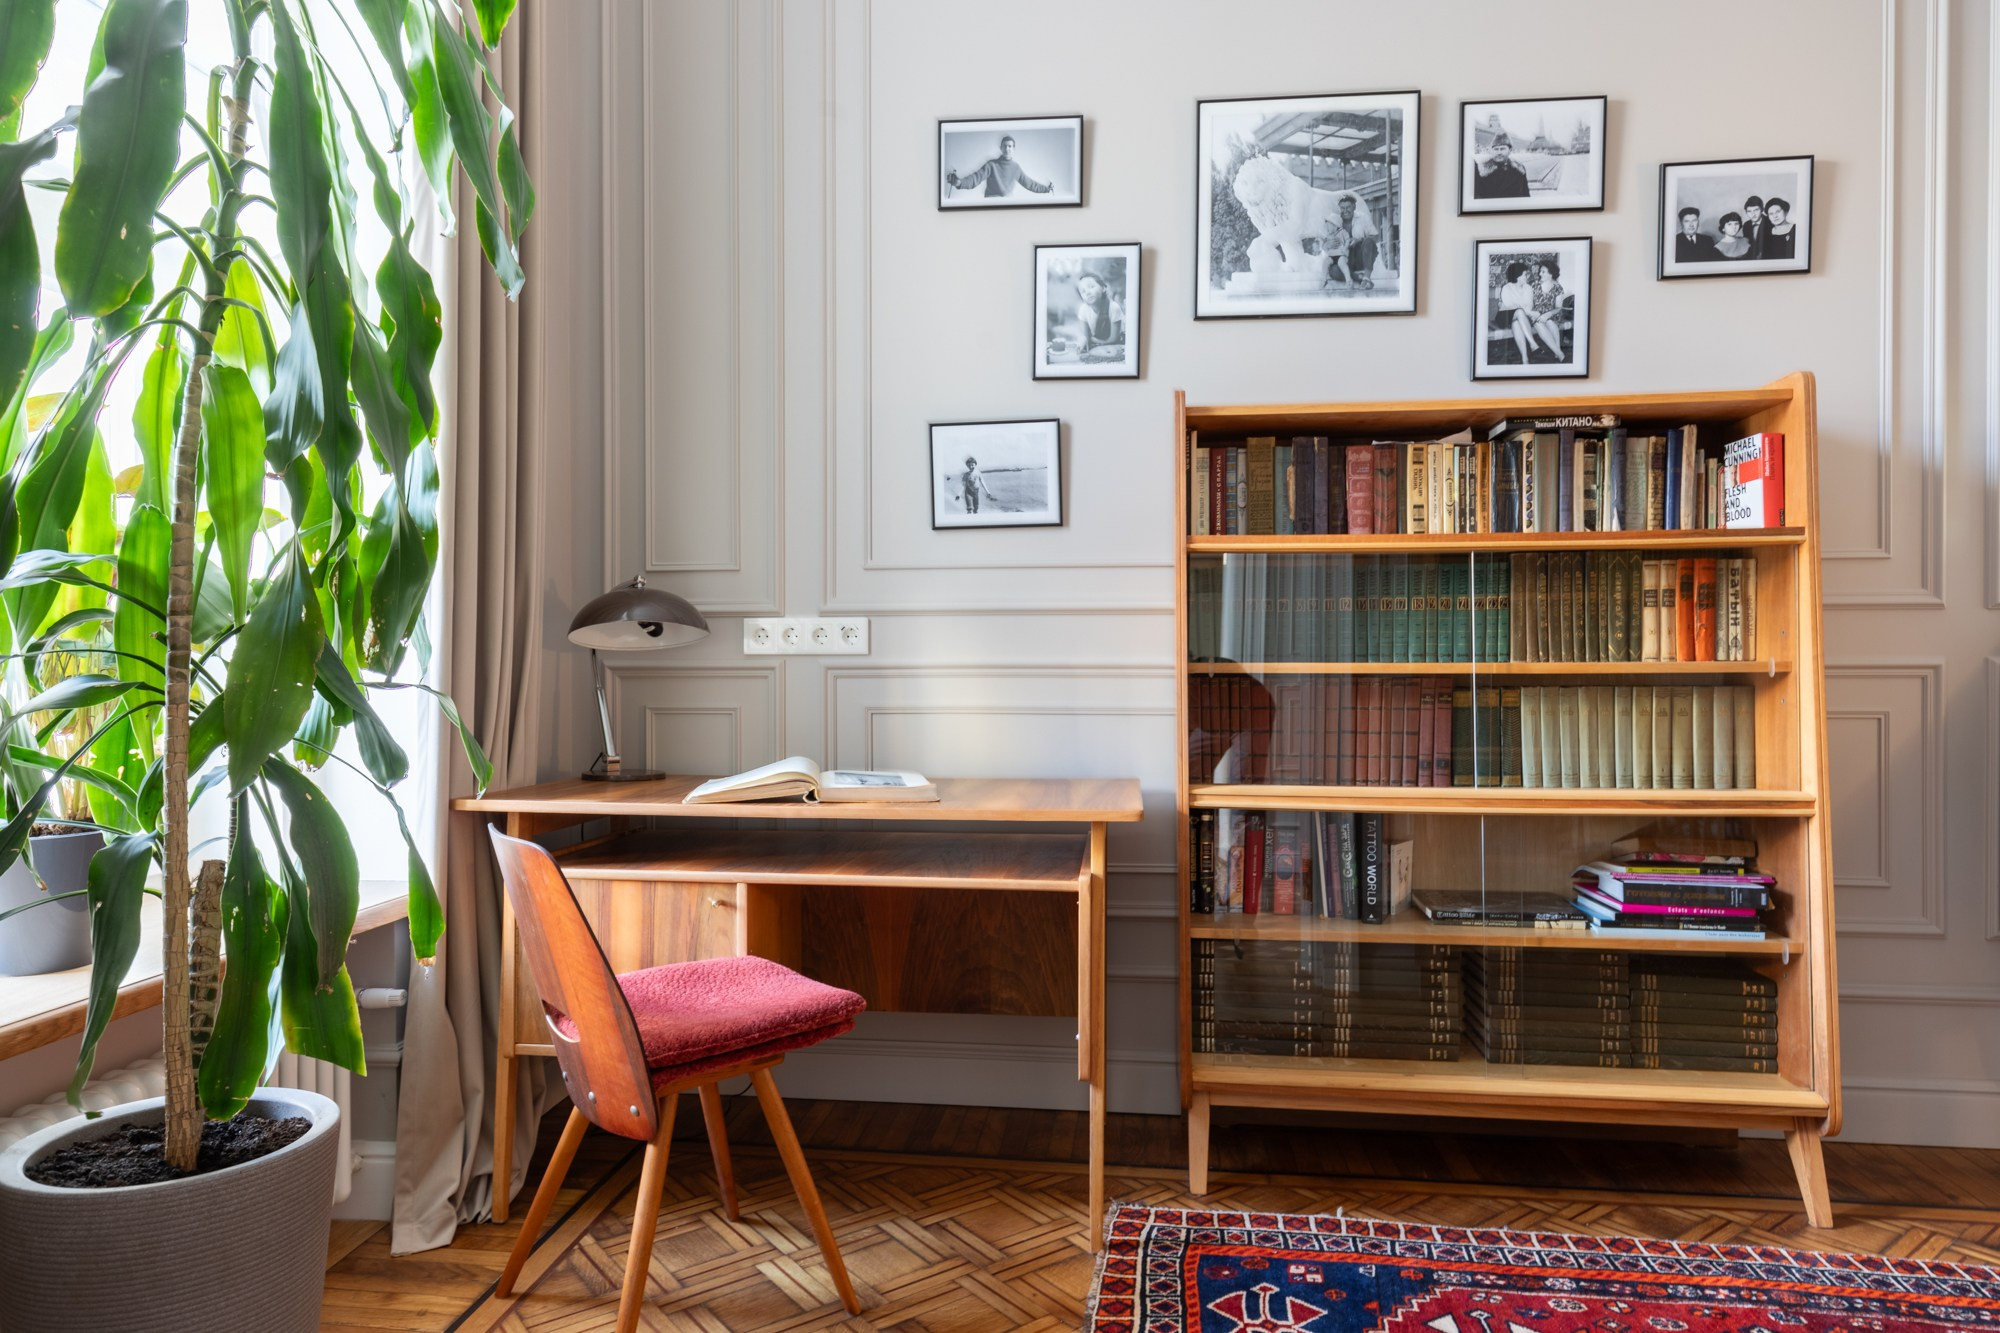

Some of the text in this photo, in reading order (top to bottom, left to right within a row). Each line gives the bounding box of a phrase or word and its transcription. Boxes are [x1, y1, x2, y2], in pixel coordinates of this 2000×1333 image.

[1556, 416, 1592, 428] КИТАНО
[1724, 437, 1756, 456] MICHAEL
[1724, 484, 1746, 499] FLESH
[1725, 498, 1741, 510] AND
[1726, 507, 1752, 522] BLOOD
[1730, 567, 1741, 626] БАТЫЙ
[1367, 820, 1377, 905] TATTOO WORLD
